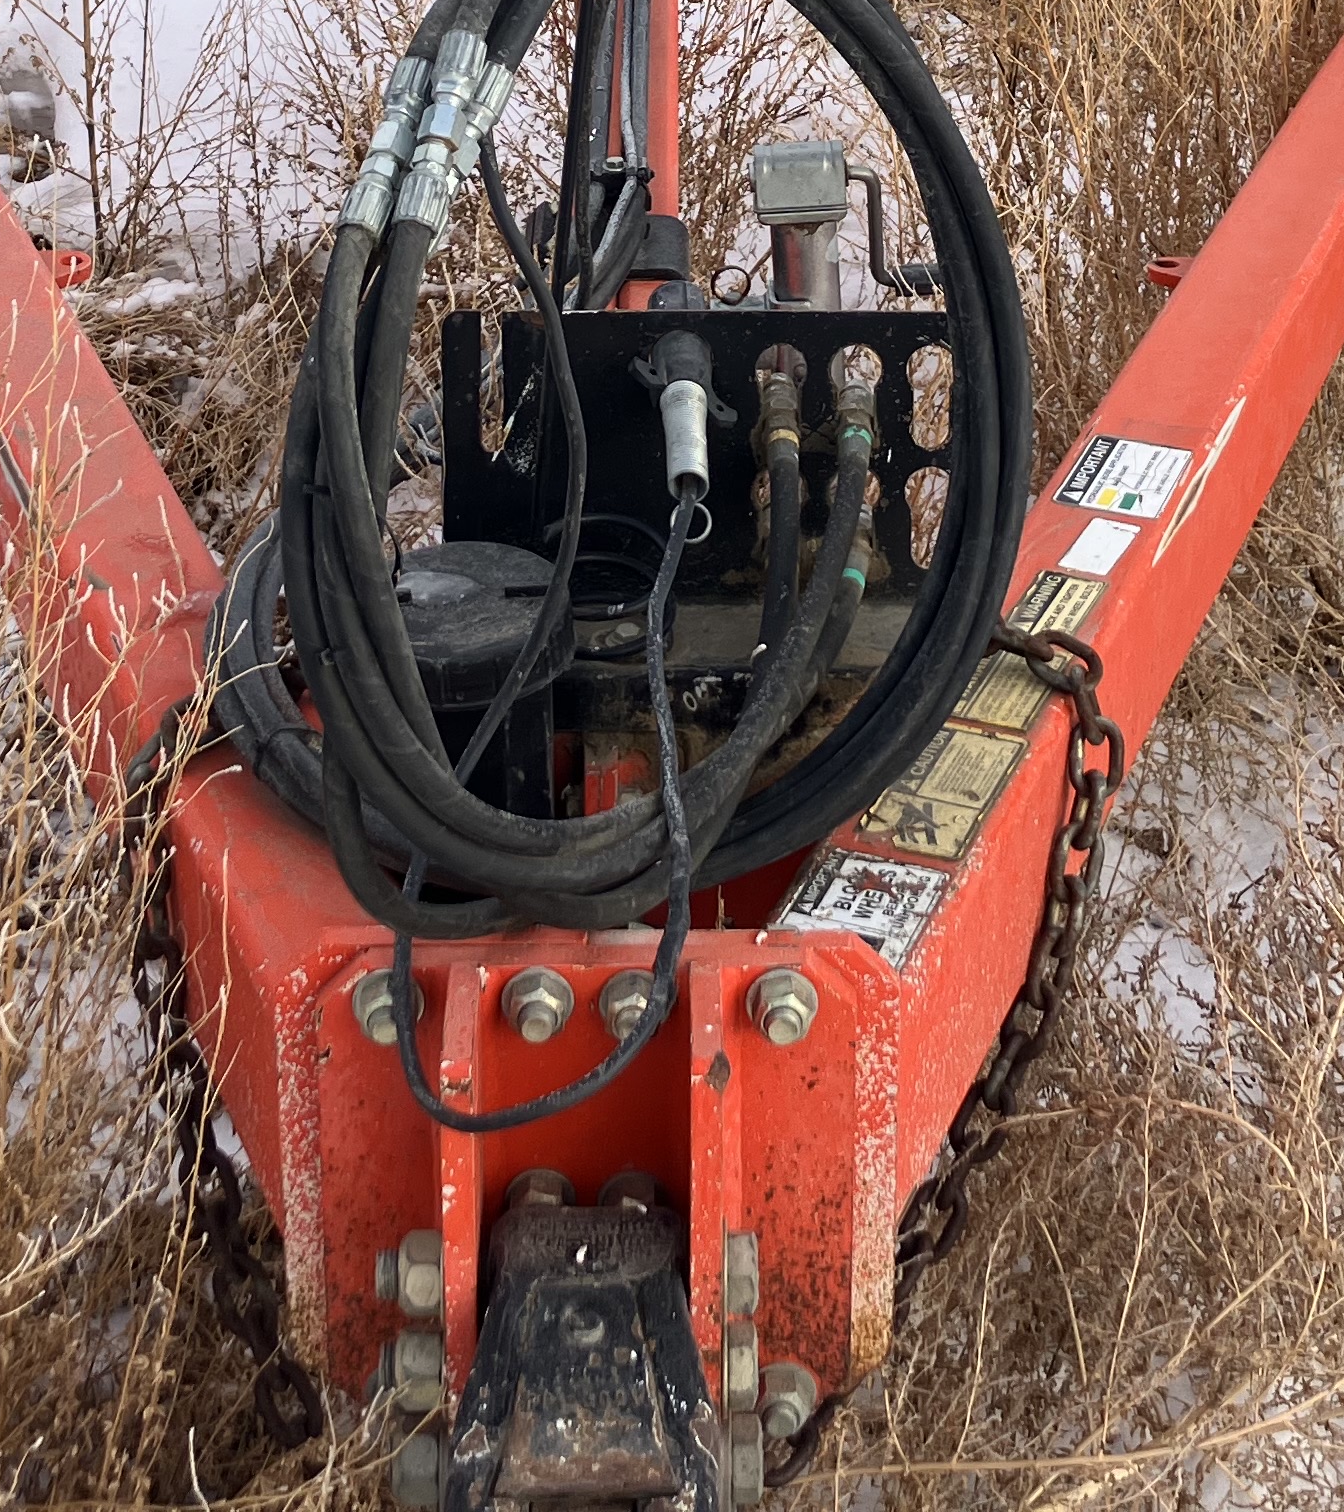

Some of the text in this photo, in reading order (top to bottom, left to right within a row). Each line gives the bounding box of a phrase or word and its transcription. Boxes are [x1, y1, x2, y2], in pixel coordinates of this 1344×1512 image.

[1071, 439, 1113, 489] IMPORTANT
[1020, 575, 1062, 619] WARNING
[1053, 603, 1066, 615] AND
[1060, 583, 1080, 604] TIGHTEN
[910, 730, 950, 776] CAUTION
